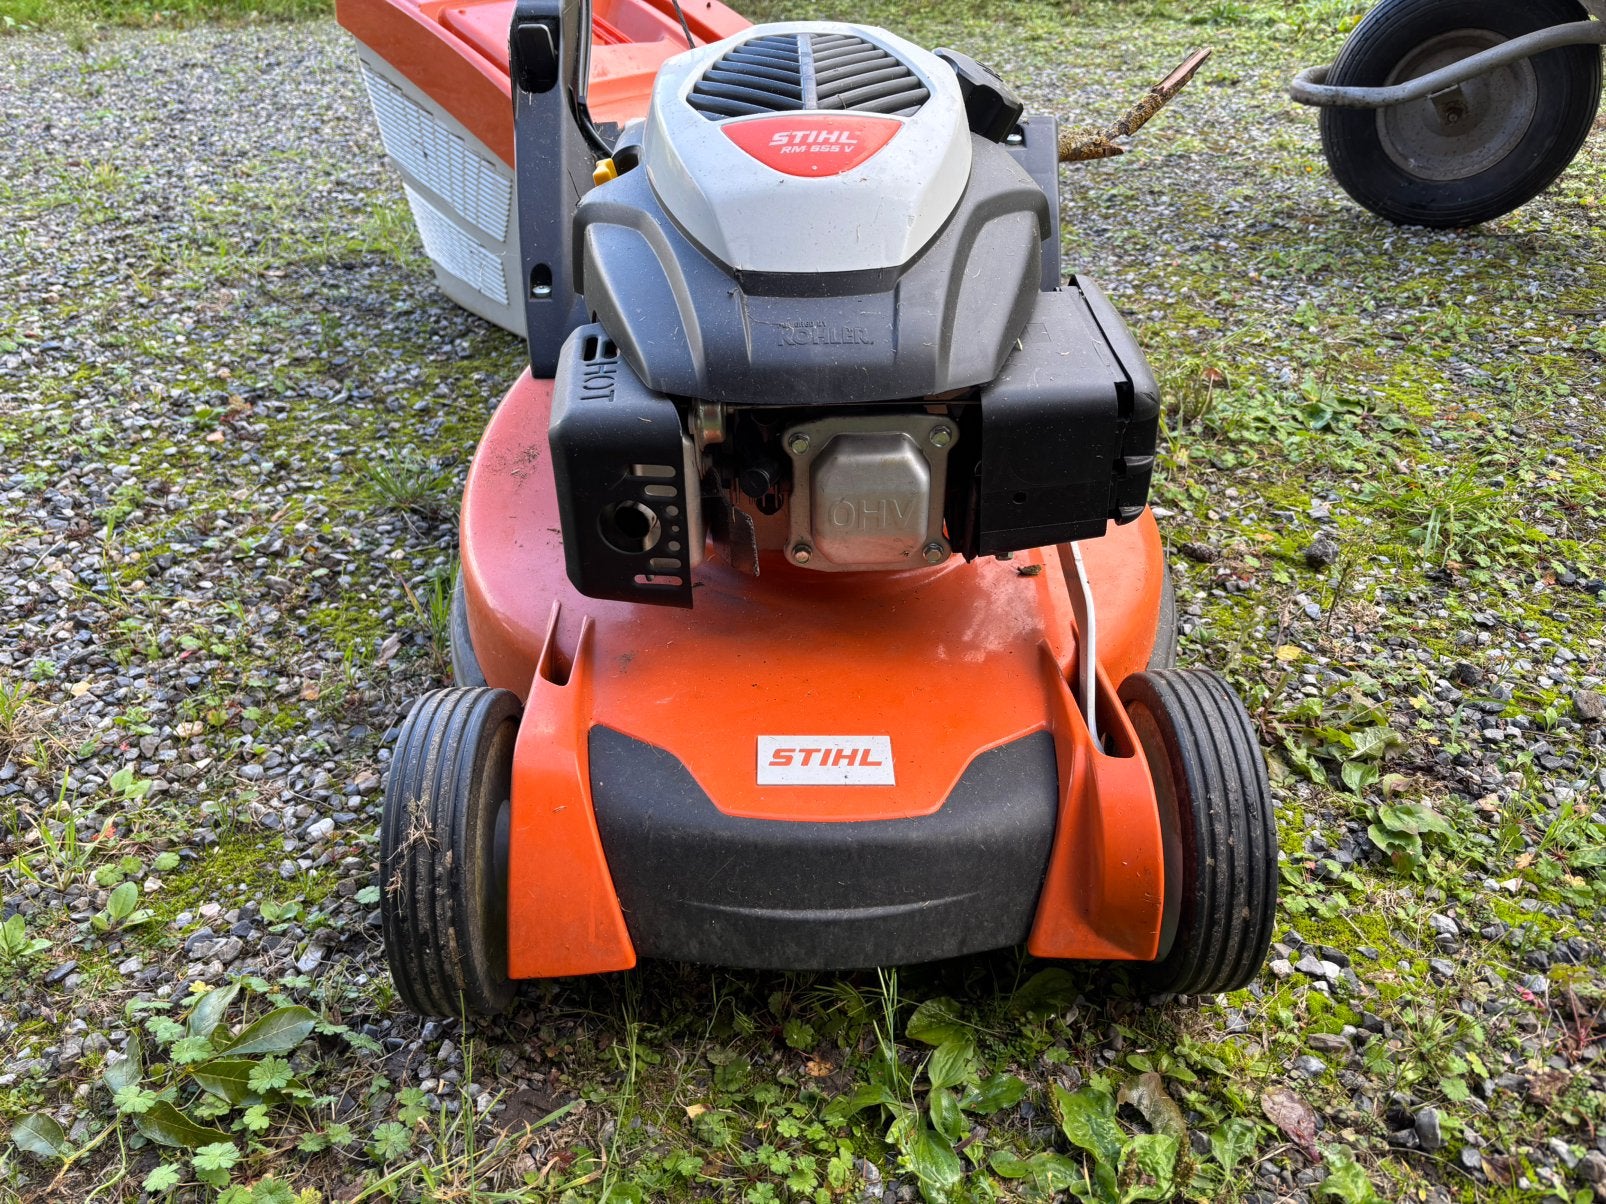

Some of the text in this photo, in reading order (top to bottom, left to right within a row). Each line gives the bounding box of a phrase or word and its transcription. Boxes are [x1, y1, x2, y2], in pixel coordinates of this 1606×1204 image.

[768, 130, 858, 146] STIHL
[780, 145, 806, 154] RM
[844, 144, 855, 153] V
[580, 361, 618, 402] HOT
[828, 499, 914, 529] OHV
[768, 748, 883, 767] STIHL
